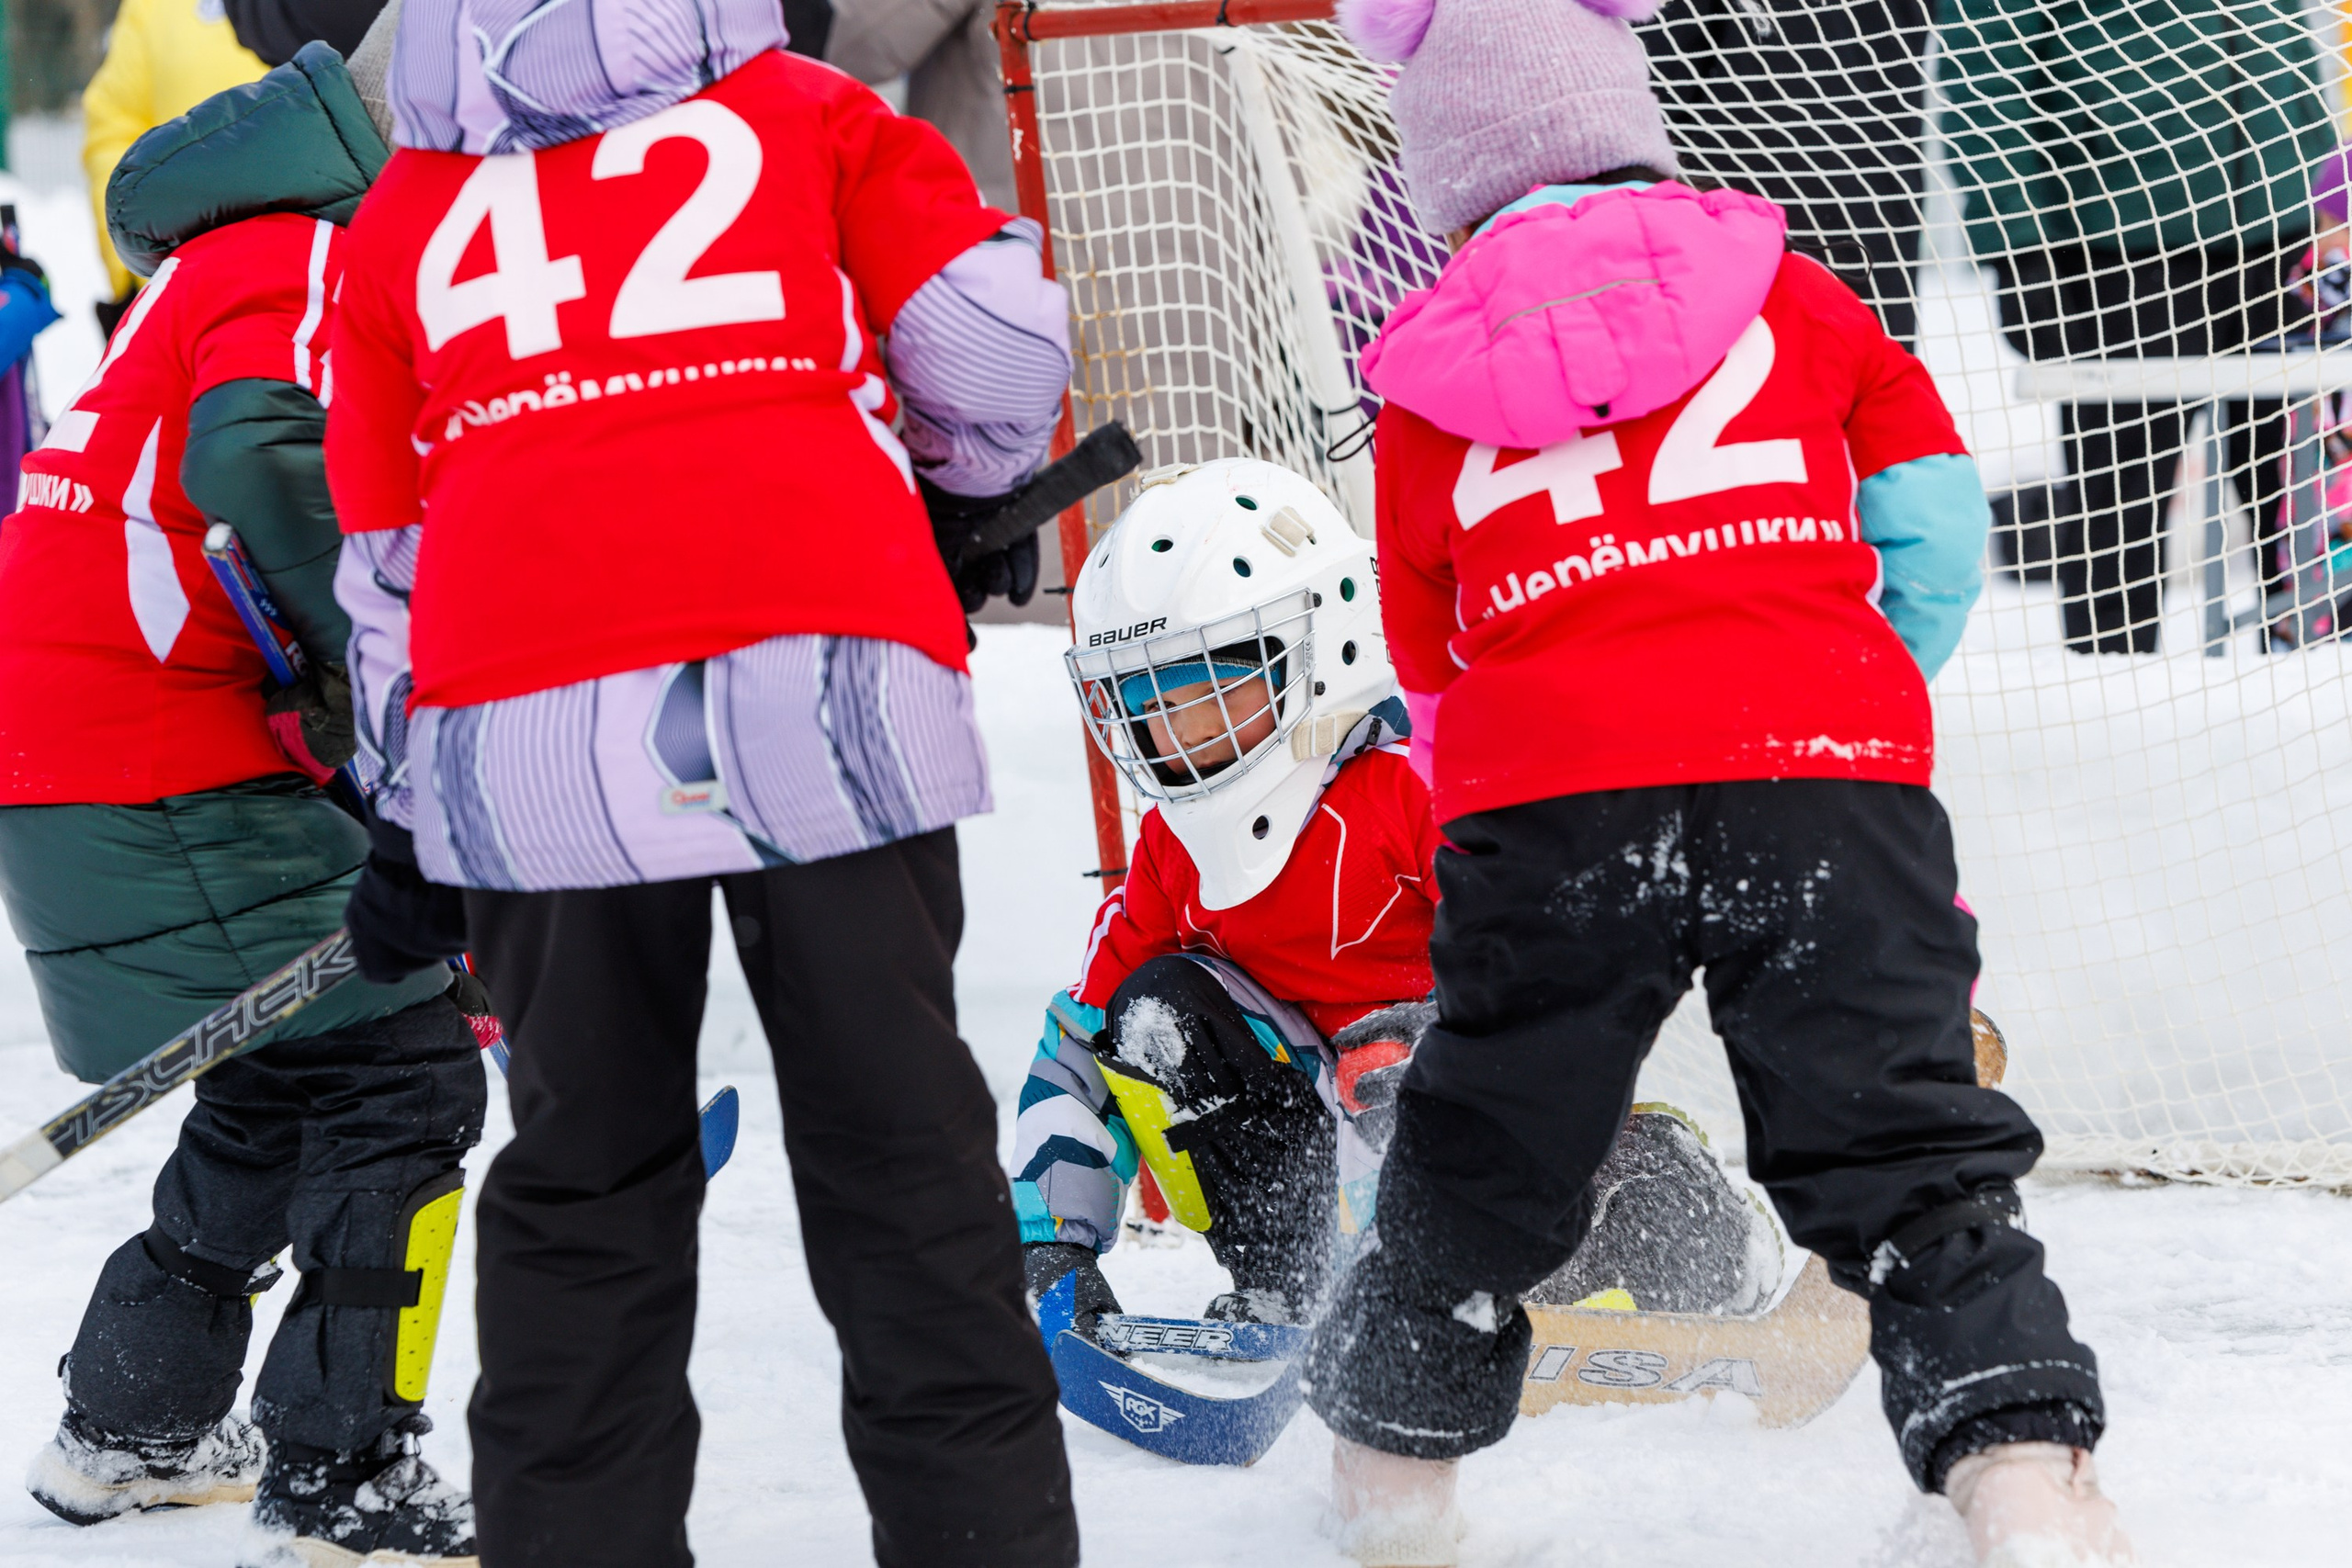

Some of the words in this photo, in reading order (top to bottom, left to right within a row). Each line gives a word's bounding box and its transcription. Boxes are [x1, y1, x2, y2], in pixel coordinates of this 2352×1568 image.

[416, 98, 786, 361] 42
[1452, 314, 1809, 532] 42
[50, 937, 358, 1146] ISCHER
[1526, 1344, 1764, 1397] ISA
